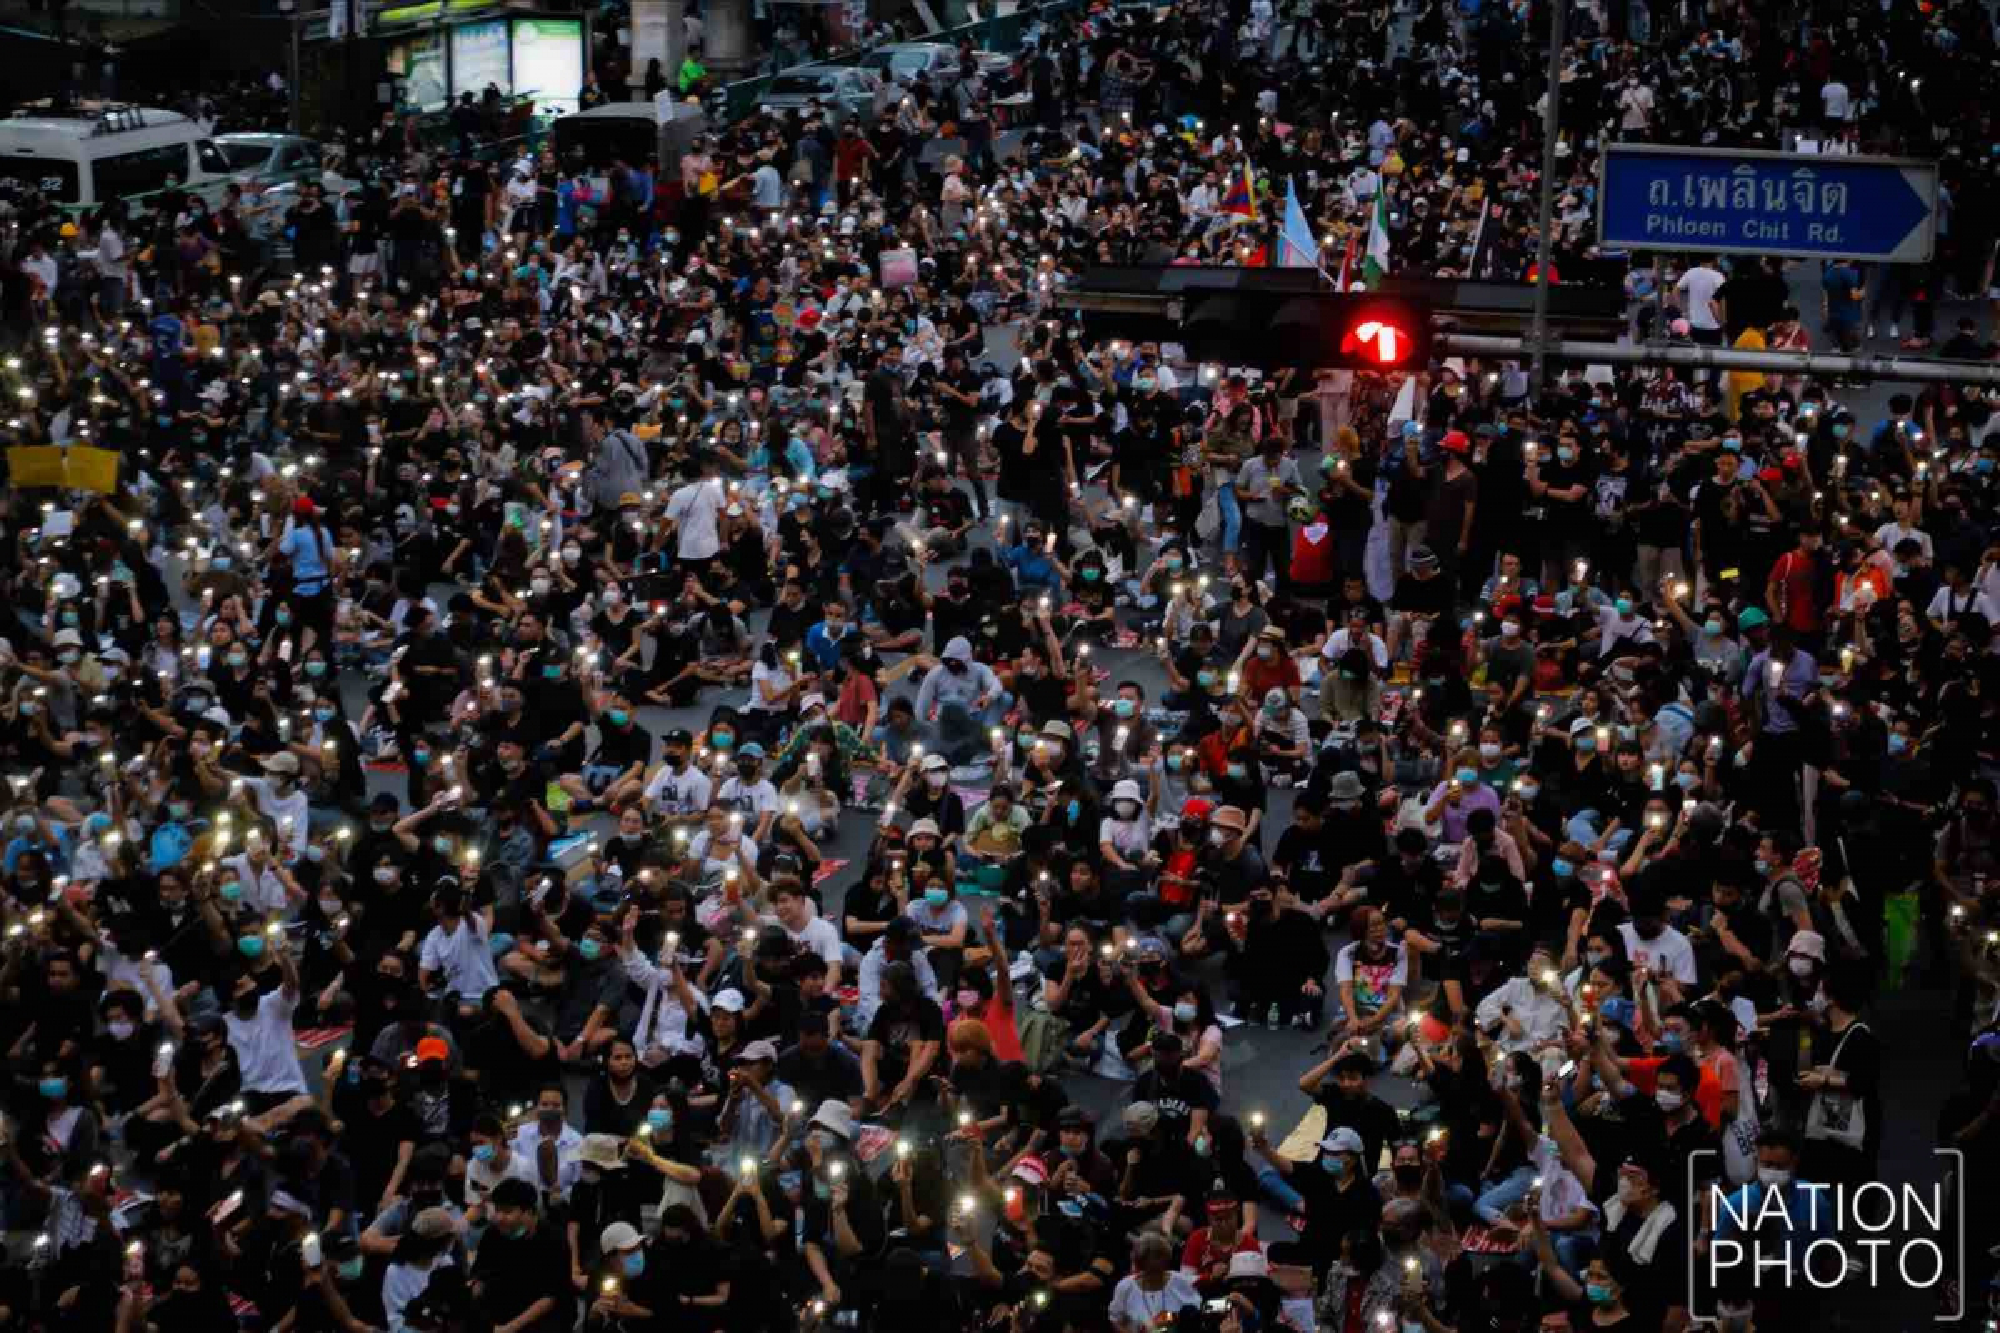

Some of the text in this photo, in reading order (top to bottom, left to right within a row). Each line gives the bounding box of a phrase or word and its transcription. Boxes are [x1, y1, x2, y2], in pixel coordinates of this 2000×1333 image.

[1647, 163, 1848, 215] ถ.เพลินจิต
[1647, 214, 1845, 243] Phloen Chit Rd.
